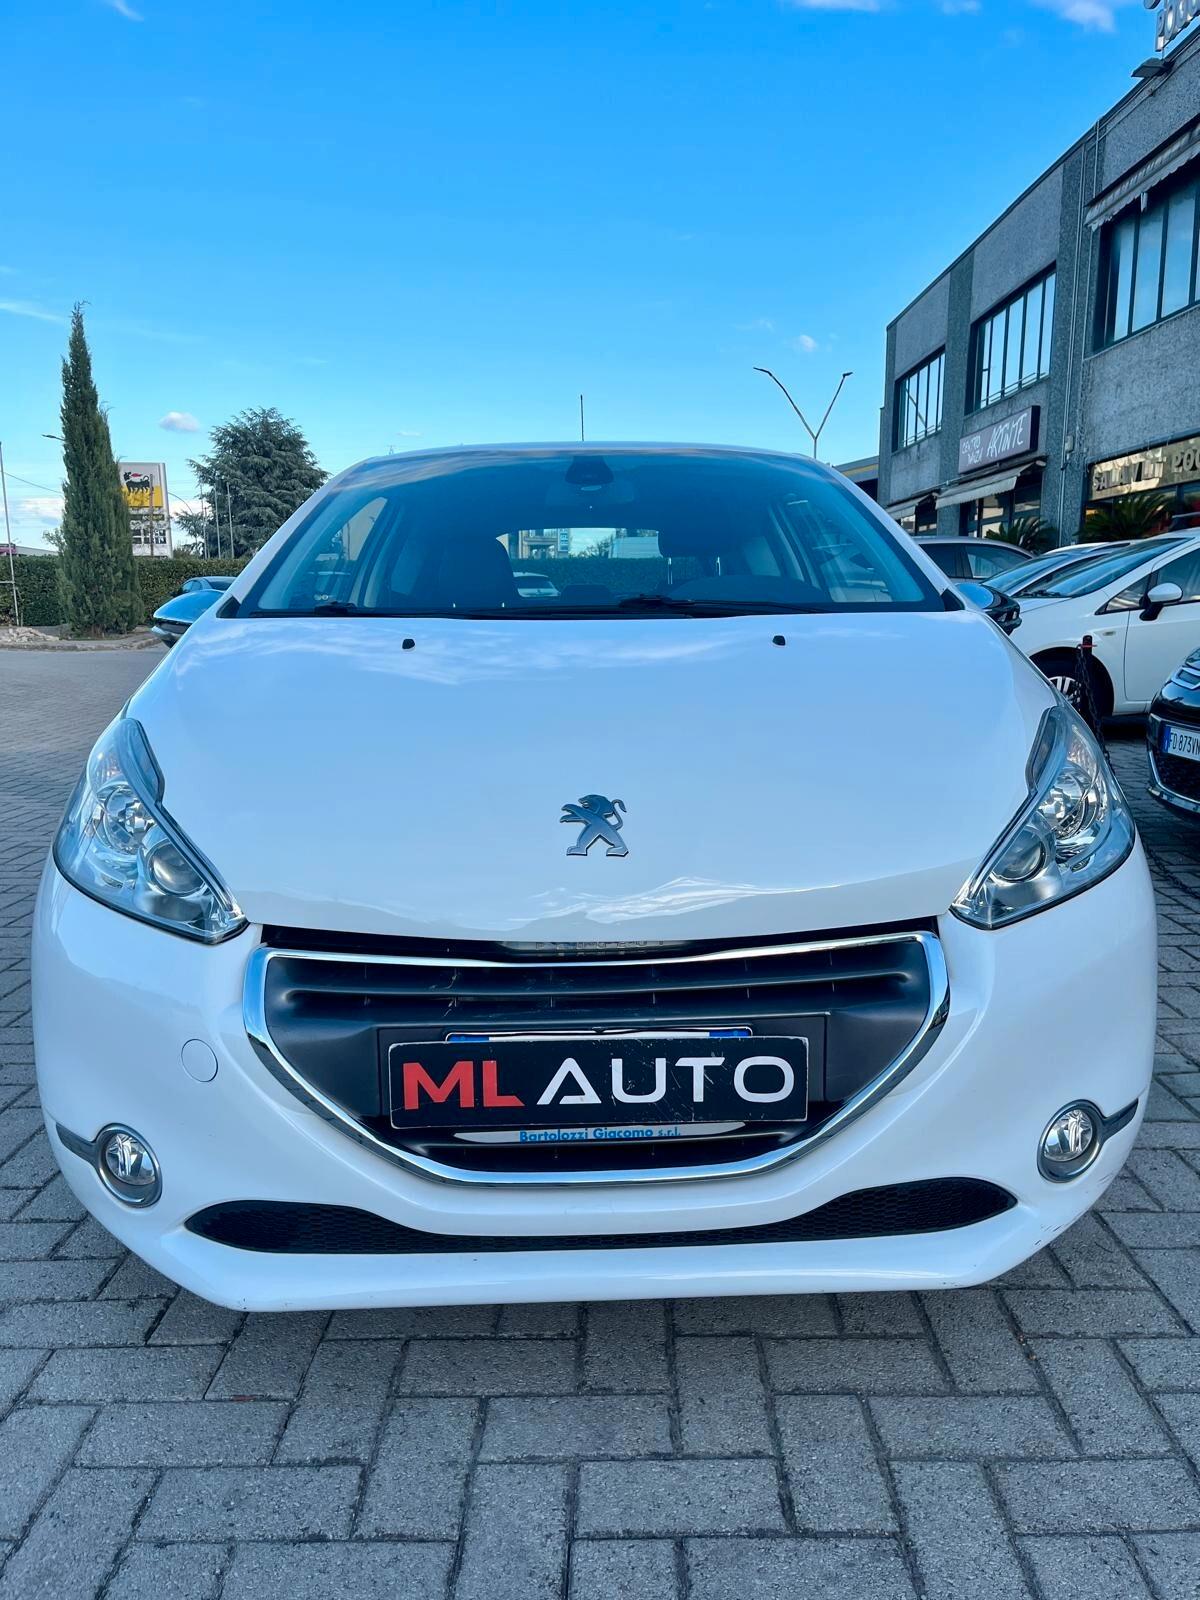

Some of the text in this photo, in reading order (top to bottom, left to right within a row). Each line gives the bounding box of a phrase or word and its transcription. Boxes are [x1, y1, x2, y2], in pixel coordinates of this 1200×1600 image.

[402, 1056, 795, 1110] ML AUTO
[519, 1126, 681, 1143] Bartolozzi Giacomo s.r.l.
